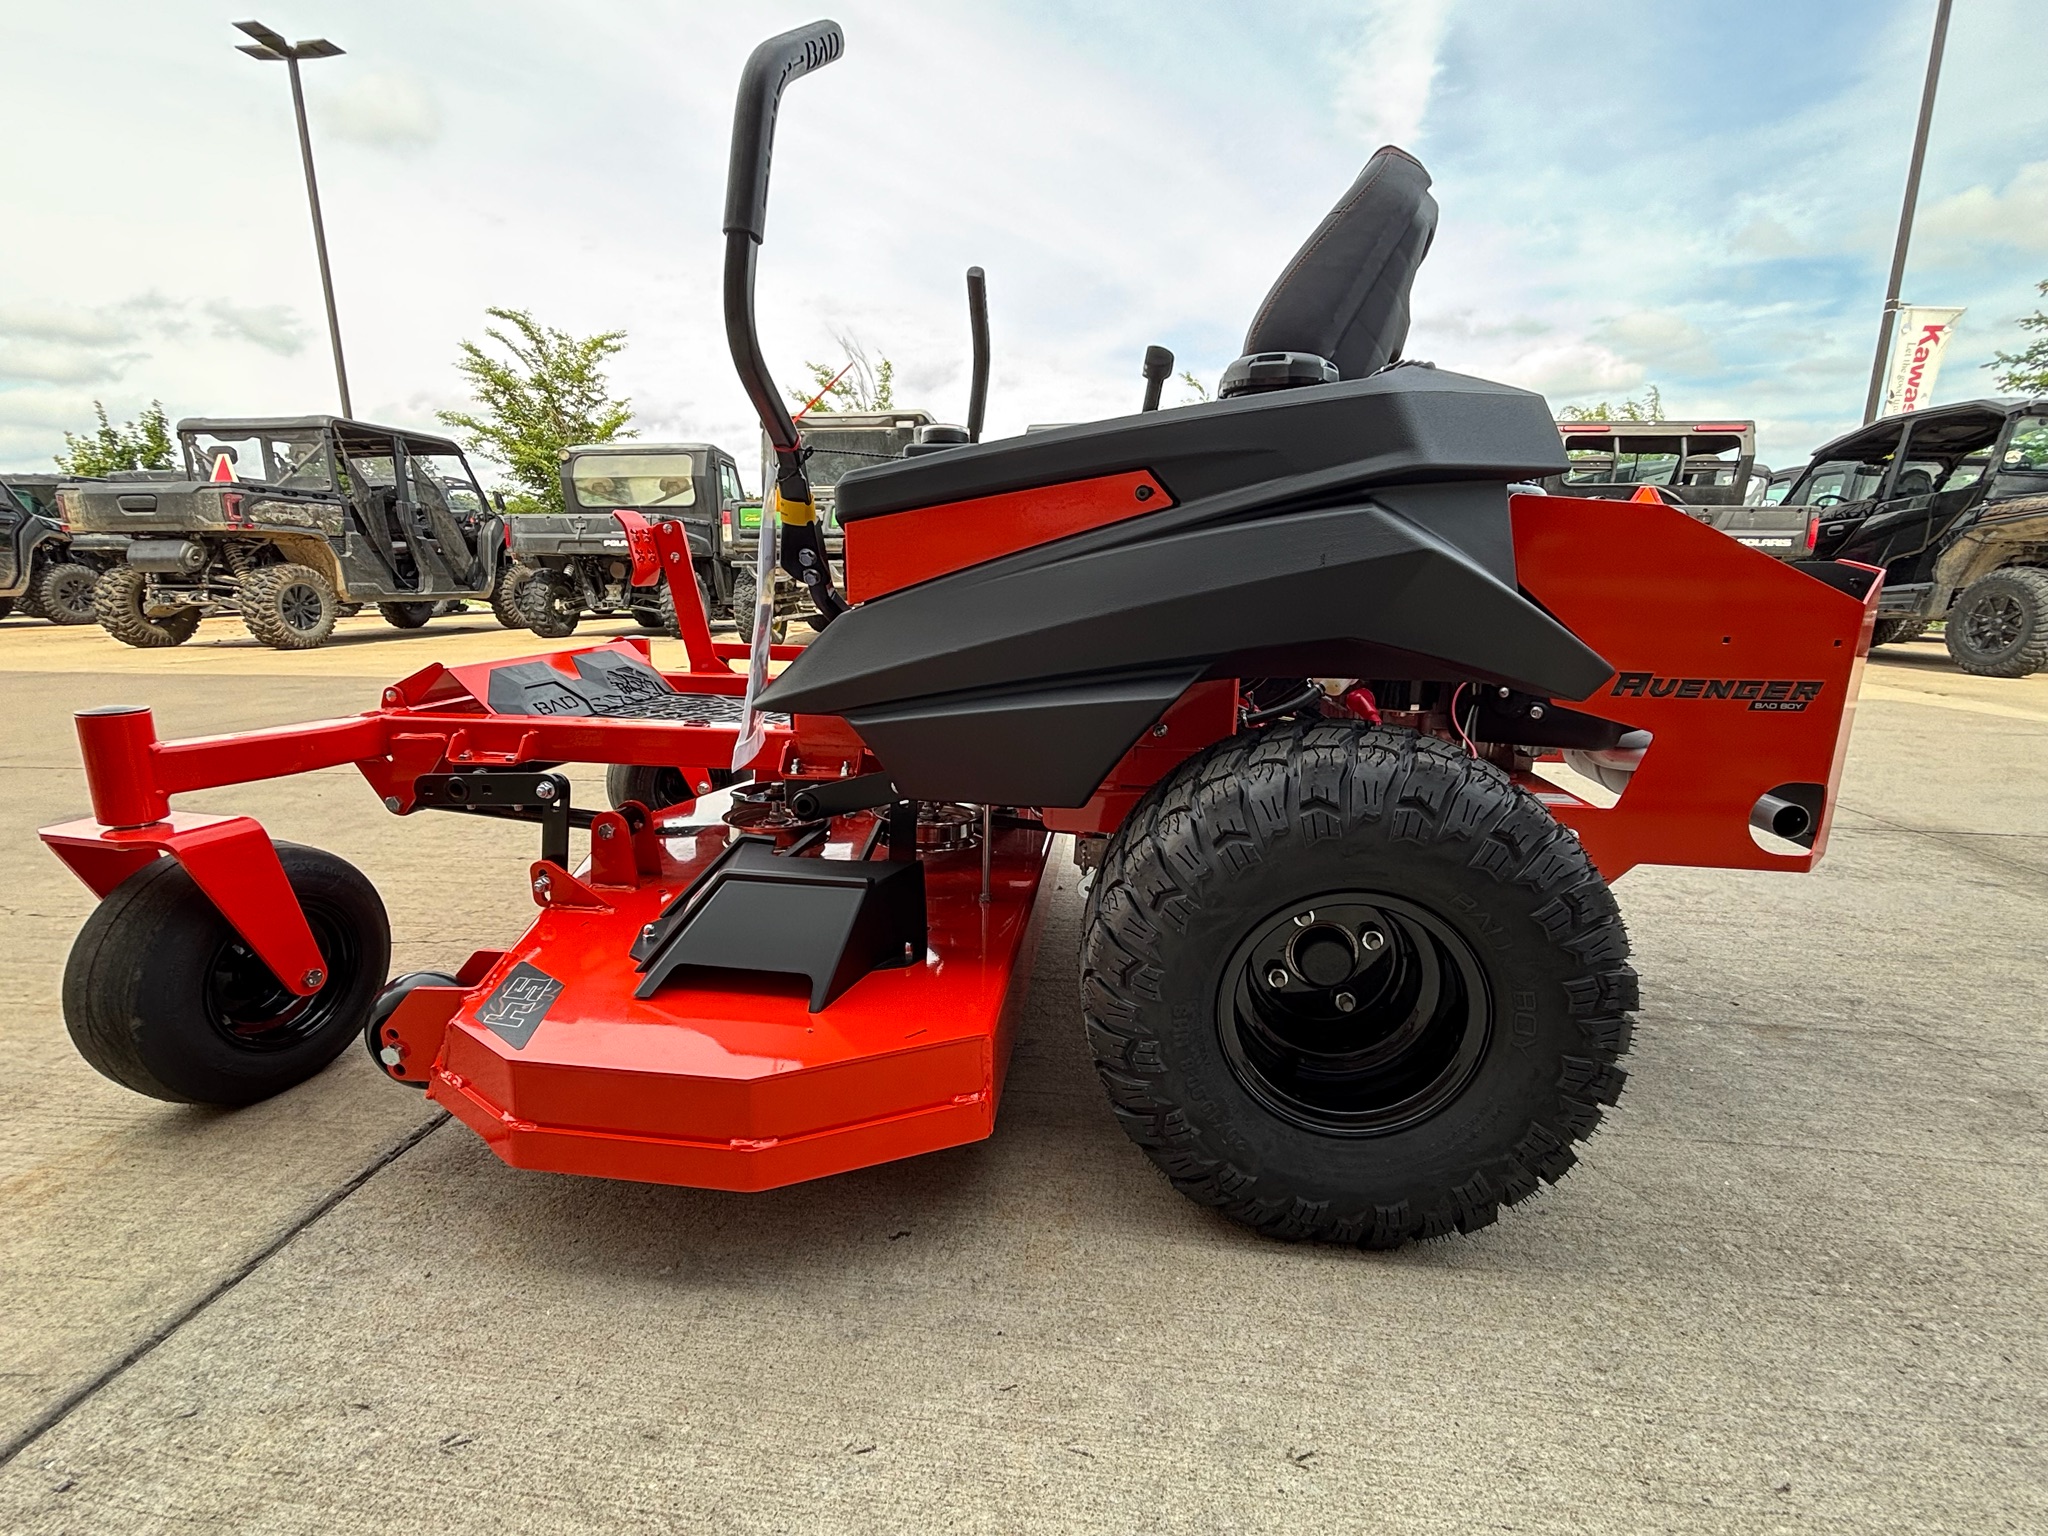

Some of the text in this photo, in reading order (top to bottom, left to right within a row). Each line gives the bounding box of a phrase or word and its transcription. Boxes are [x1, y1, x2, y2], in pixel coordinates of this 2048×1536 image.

[805, 32, 839, 70] BAD
[1610, 672, 1825, 701] AVENGER
[1754, 702, 1804, 710] BAD BOY
[1448, 892, 1537, 1058] BAD BOY
